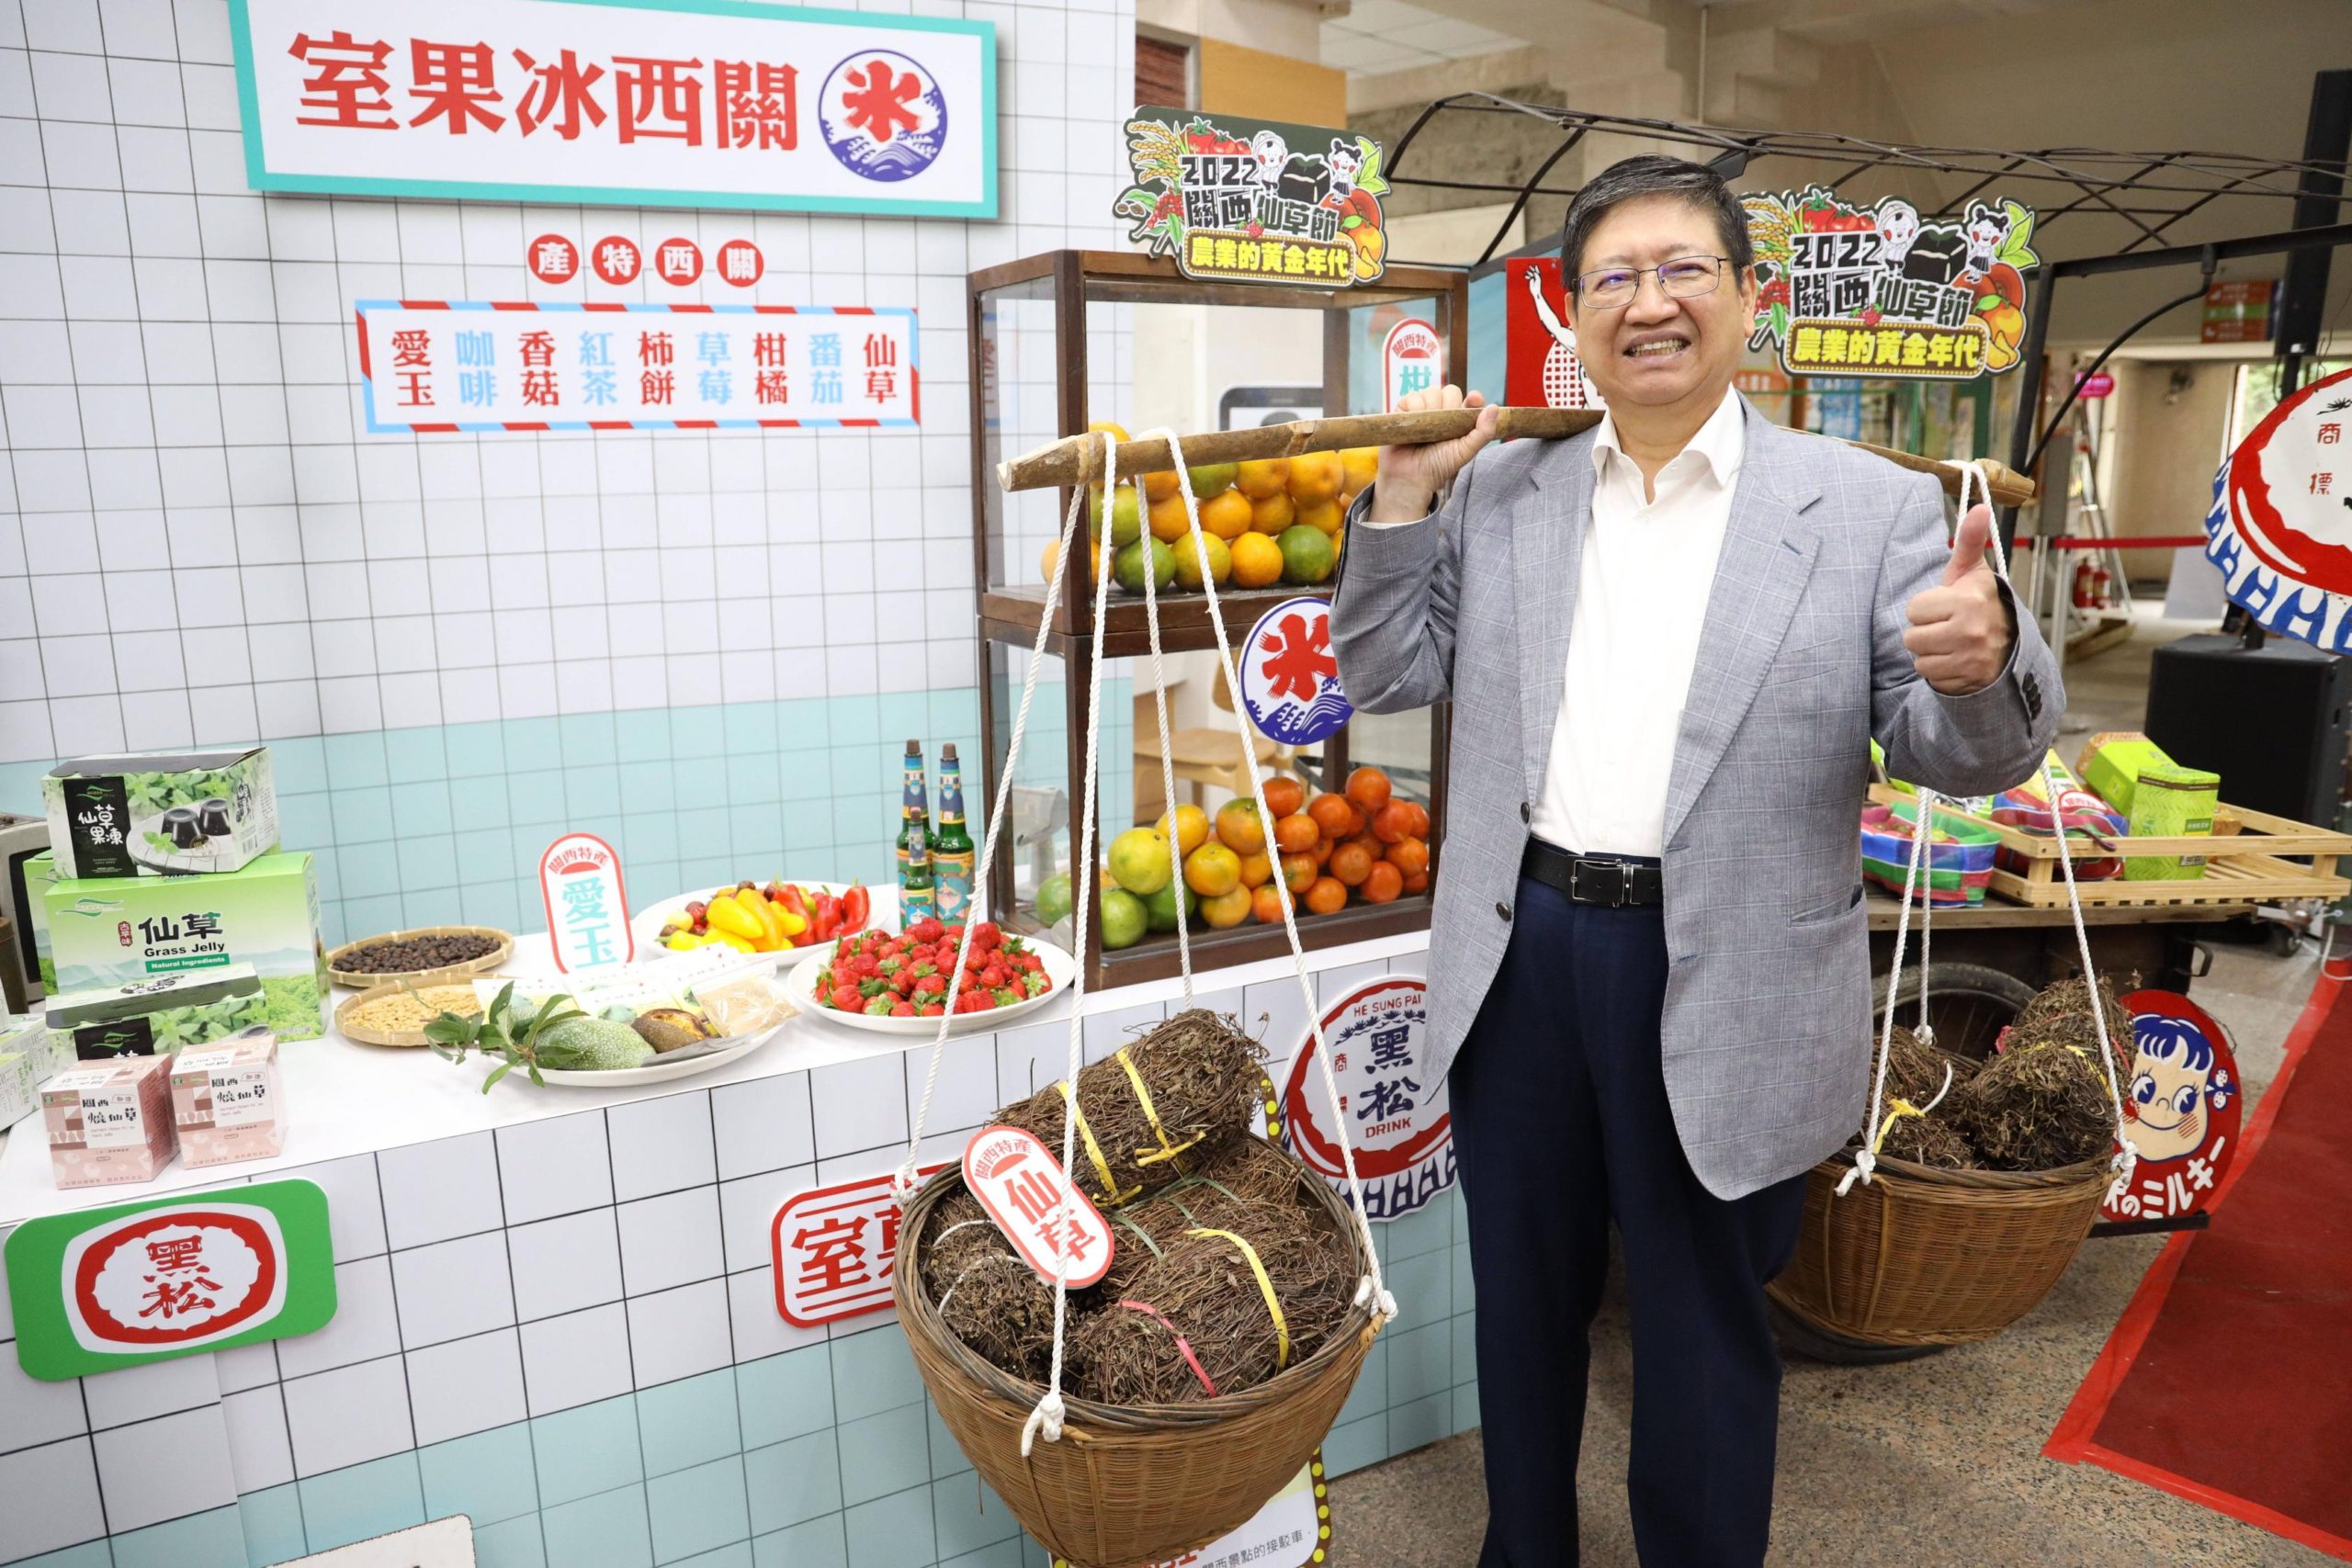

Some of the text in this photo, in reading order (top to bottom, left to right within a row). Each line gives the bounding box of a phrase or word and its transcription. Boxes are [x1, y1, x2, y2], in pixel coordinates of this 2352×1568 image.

[1181, 156, 1260, 186] 2022
[1792, 233, 1883, 269] 2022
[391, 329, 435, 406] 愛玉
[455, 330, 499, 407] 咖啡
[518, 330, 560, 407] 香菇
[578, 330, 617, 406] 紅茶
[639, 331, 675, 405] 柿餅
[695, 331, 733, 405] 草莓
[752, 332, 788, 405] 柑橘
[808, 332, 843, 404] 番茄
[864, 333, 898, 404] 仙草
[77, 803, 116, 829] 仙草
[547, 845, 610, 874] 關西特產
[119, 922, 133, 946] 古早味
[138, 911, 223, 945] 仙草
[144, 942, 225, 957] Grass Jelly
[561, 875, 618, 969] 愛玉
[151, 955, 225, 969] Natural Ingredients
[1353, 993, 1421, 1018] HE SUNG PAI
[1357, 1024, 1421, 1122] 黑松
[975, 1138, 1033, 1180] 關西特產
[1365, 1117, 1412, 1139] DRINK
[1003, 1168, 1097, 1262] 仙草
[138, 1234, 225, 1320] 黑松
